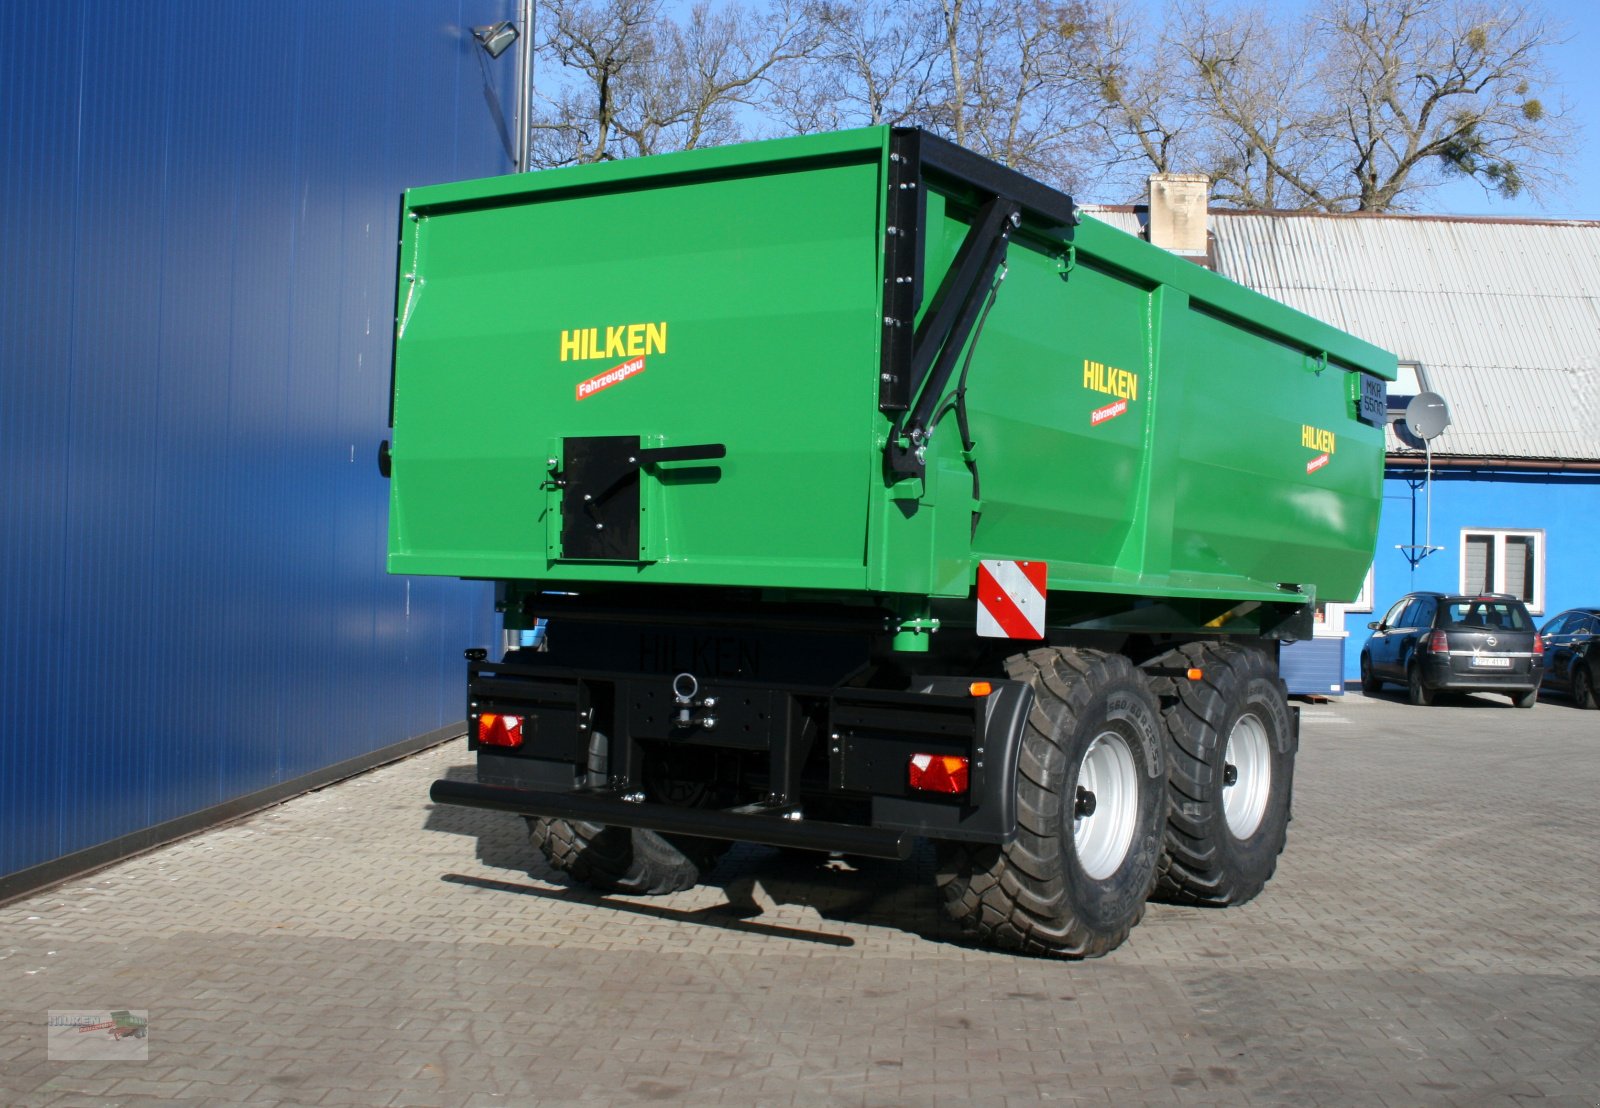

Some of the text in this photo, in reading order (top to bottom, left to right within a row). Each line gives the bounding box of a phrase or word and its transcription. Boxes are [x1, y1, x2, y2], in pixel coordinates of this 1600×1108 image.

[560, 322, 667, 361] HILKEN
[578, 358, 643, 396] Fahrzeugbau
[1083, 359, 1137, 401] HILKEN
[1366, 378, 1382, 399] MKR
[1364, 396, 1384, 416] 5500
[1301, 424, 1335, 455] HILKEN
[639, 632, 761, 678] HILKEN
